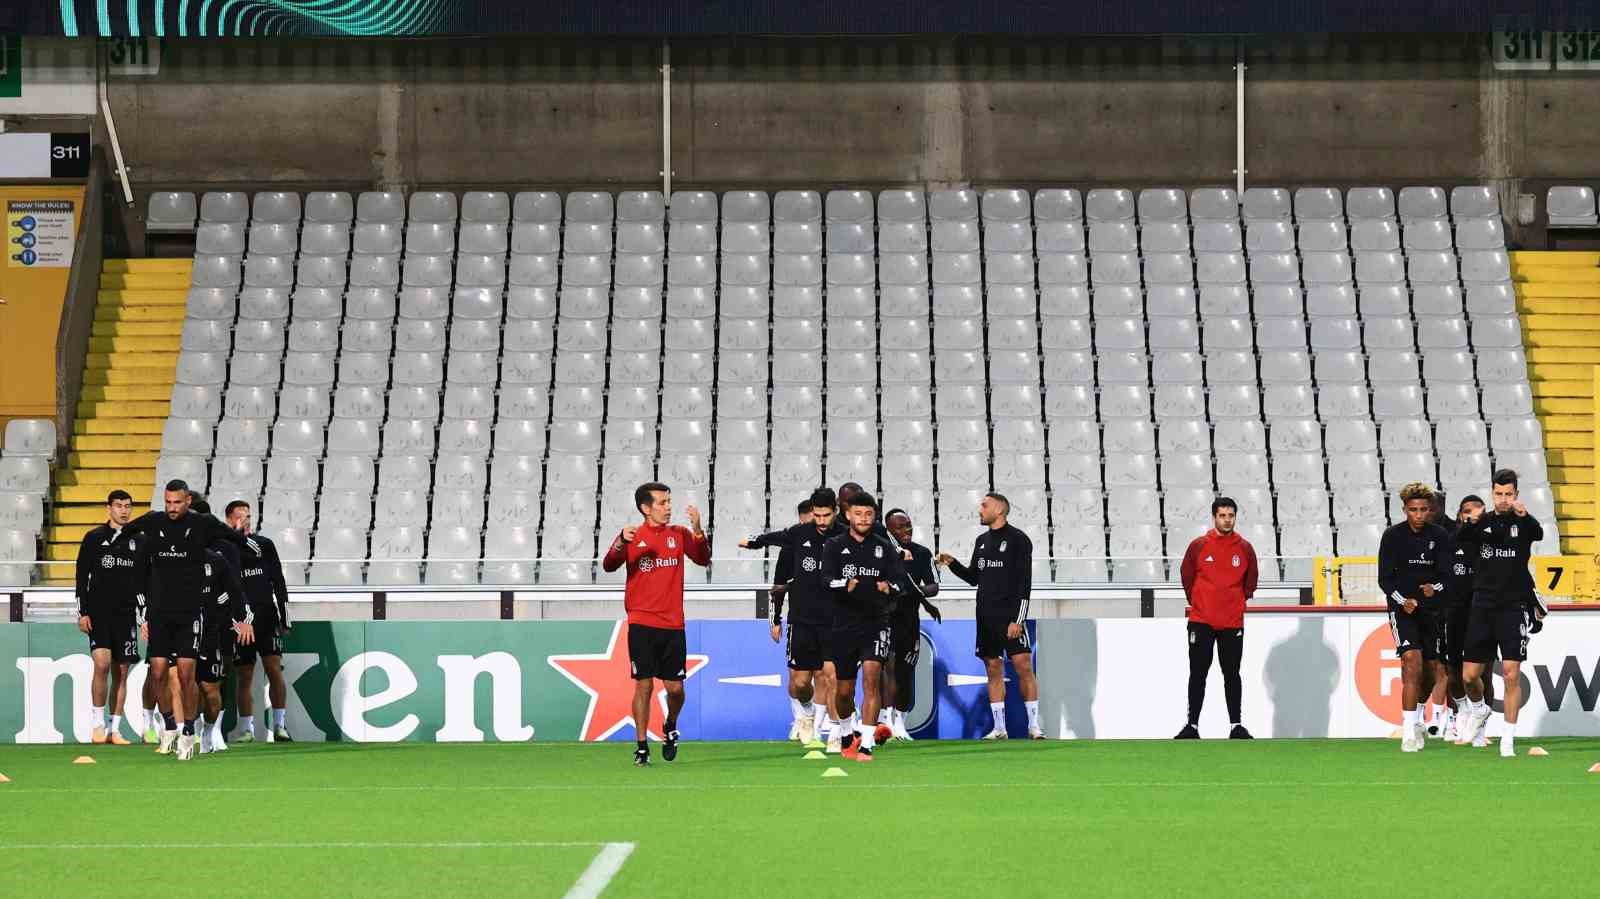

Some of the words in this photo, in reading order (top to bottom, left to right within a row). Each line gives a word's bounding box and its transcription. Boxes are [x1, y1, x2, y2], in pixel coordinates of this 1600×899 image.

[1503, 29, 1543, 60] 311
[52, 145, 81, 159] 311
[1495, 548, 1516, 558] Rain
[116, 557, 134, 567] Rain
[655, 556, 678, 568] Rain
[986, 559, 1004, 568] Rain
[244, 567, 264, 577] Rain
[858, 566, 880, 577] Rain
[1546, 566, 1564, 591] 7
